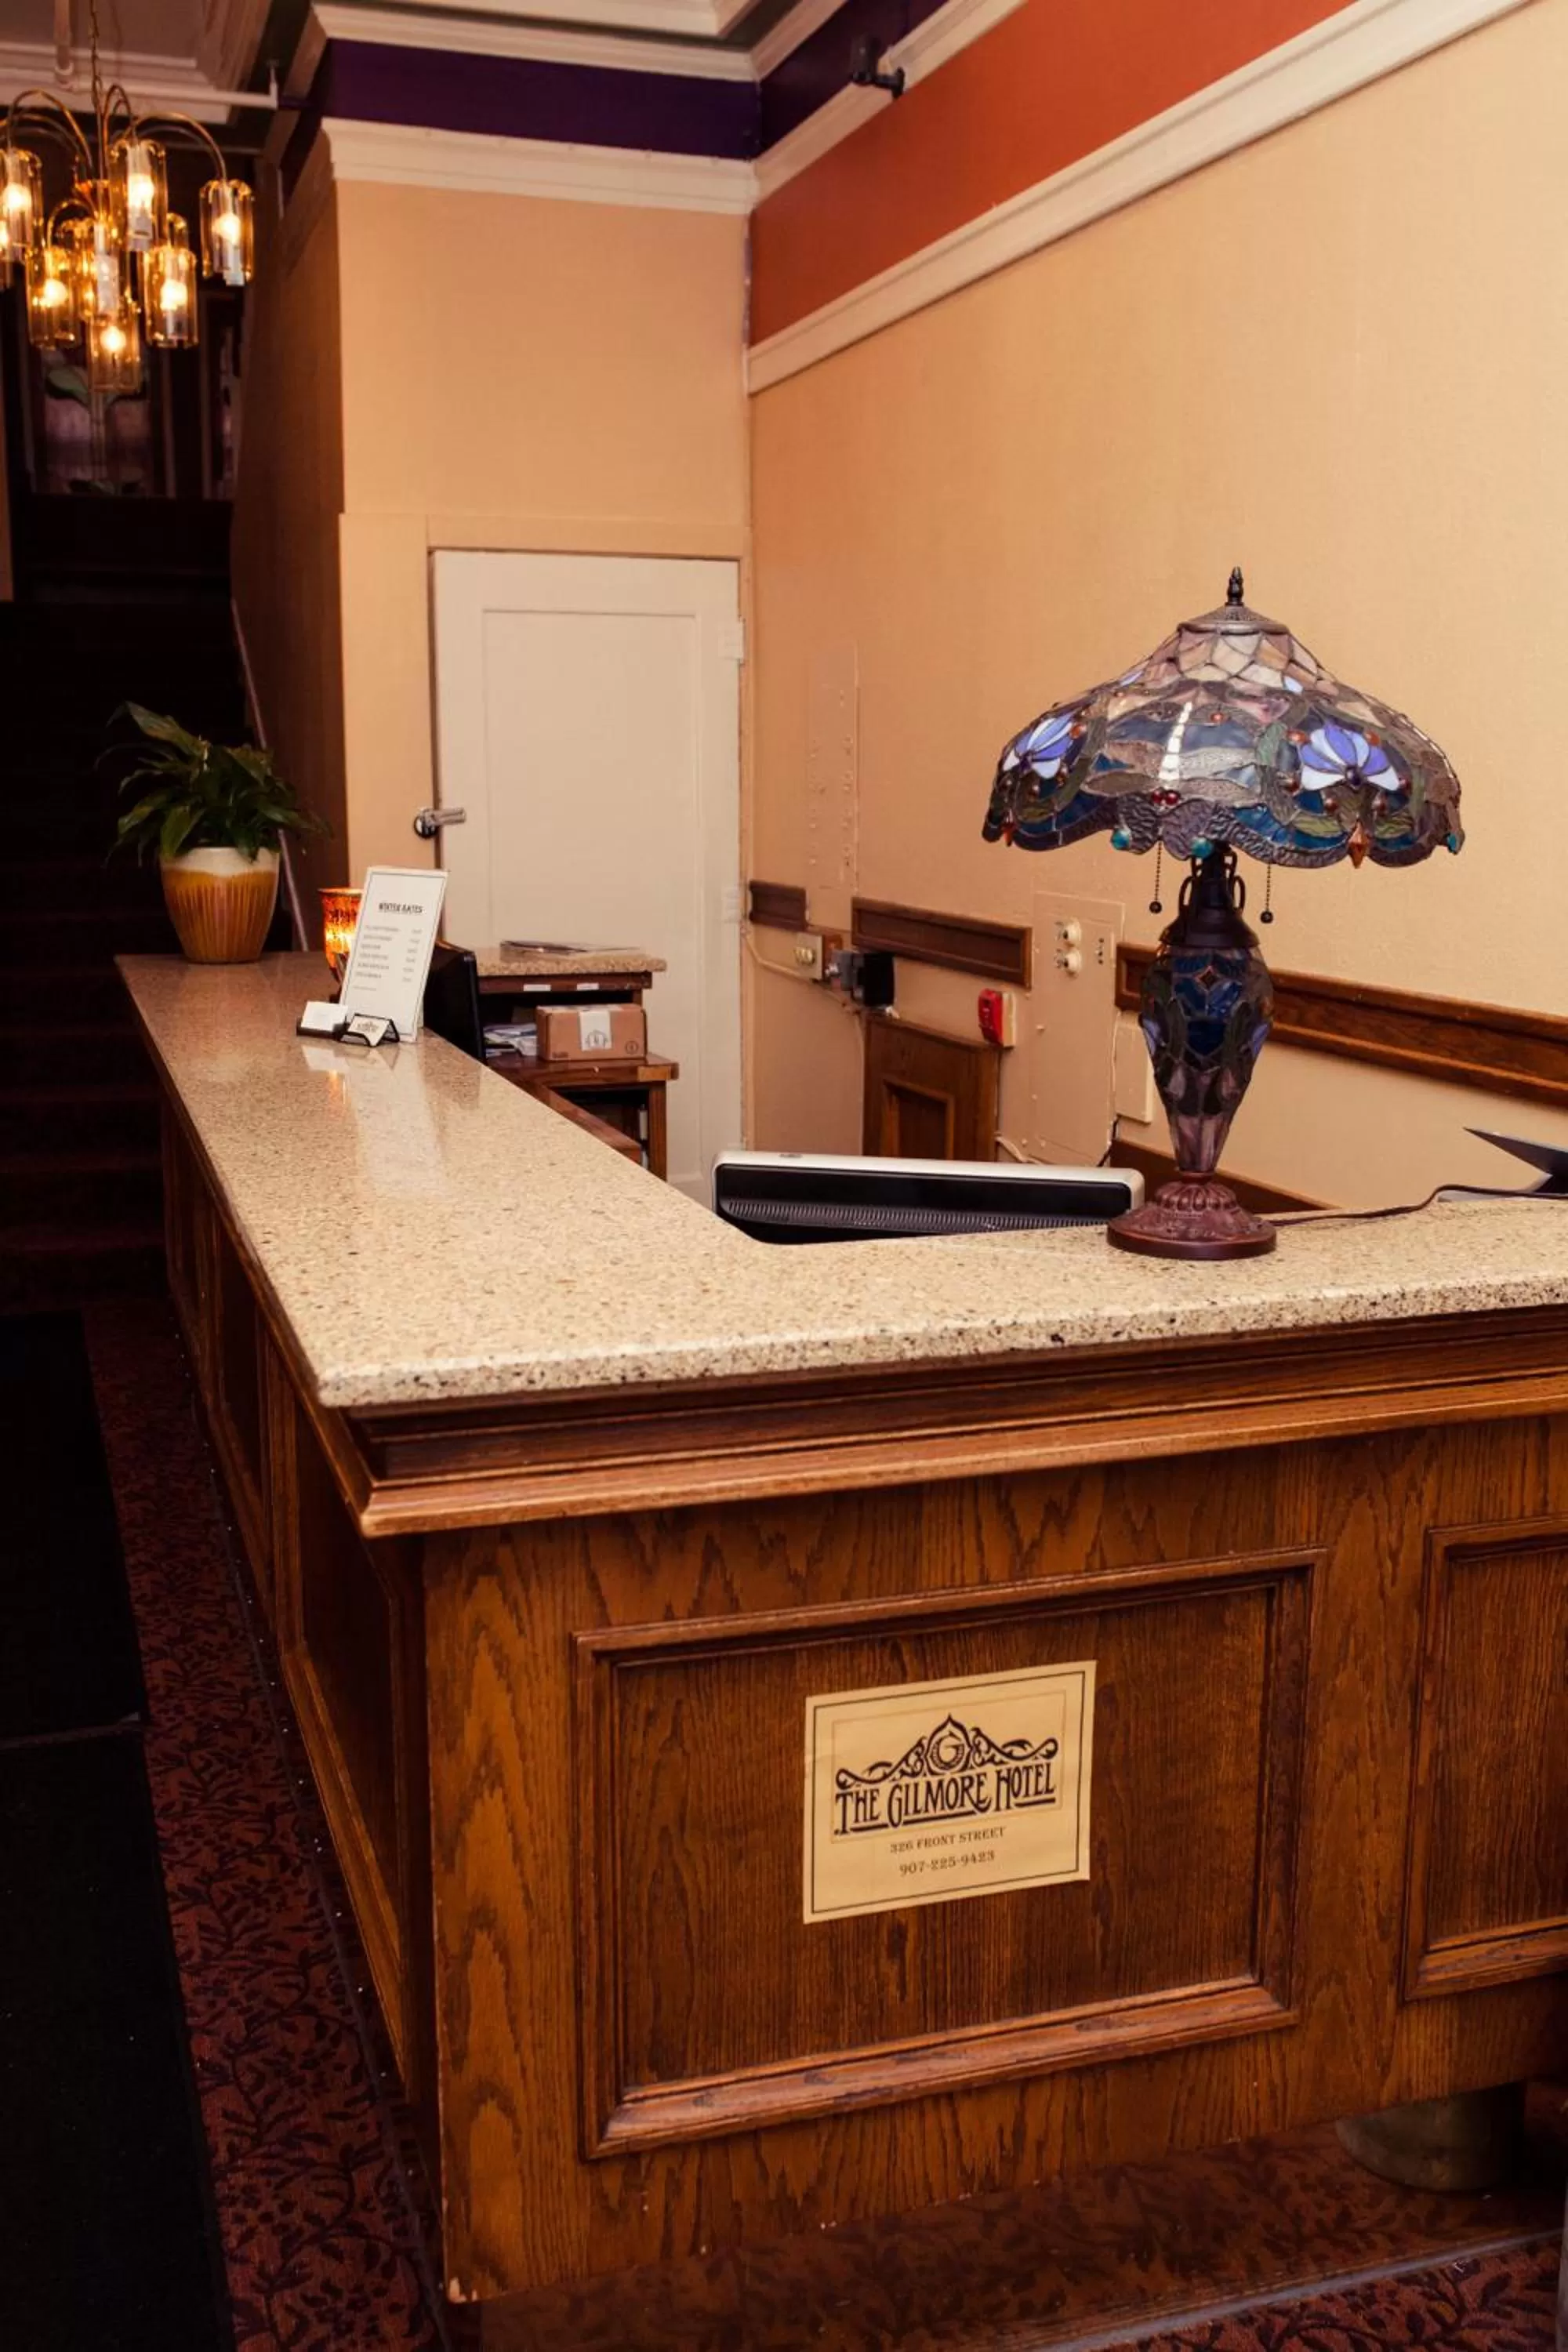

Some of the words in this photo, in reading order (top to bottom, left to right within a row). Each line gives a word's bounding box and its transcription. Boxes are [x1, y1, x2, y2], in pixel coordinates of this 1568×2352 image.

[930, 1730, 965, 1771] G
[834, 1786, 882, 1836] THE
[887, 1772, 992, 1828] GILMORE
[995, 1762, 1056, 1812] HOTEL
[890, 1839, 913, 1853] 326
[916, 1834, 956, 1849] FRONT
[959, 1826, 1006, 1843] STREET
[899, 1849, 995, 1877] 907-225-9423
